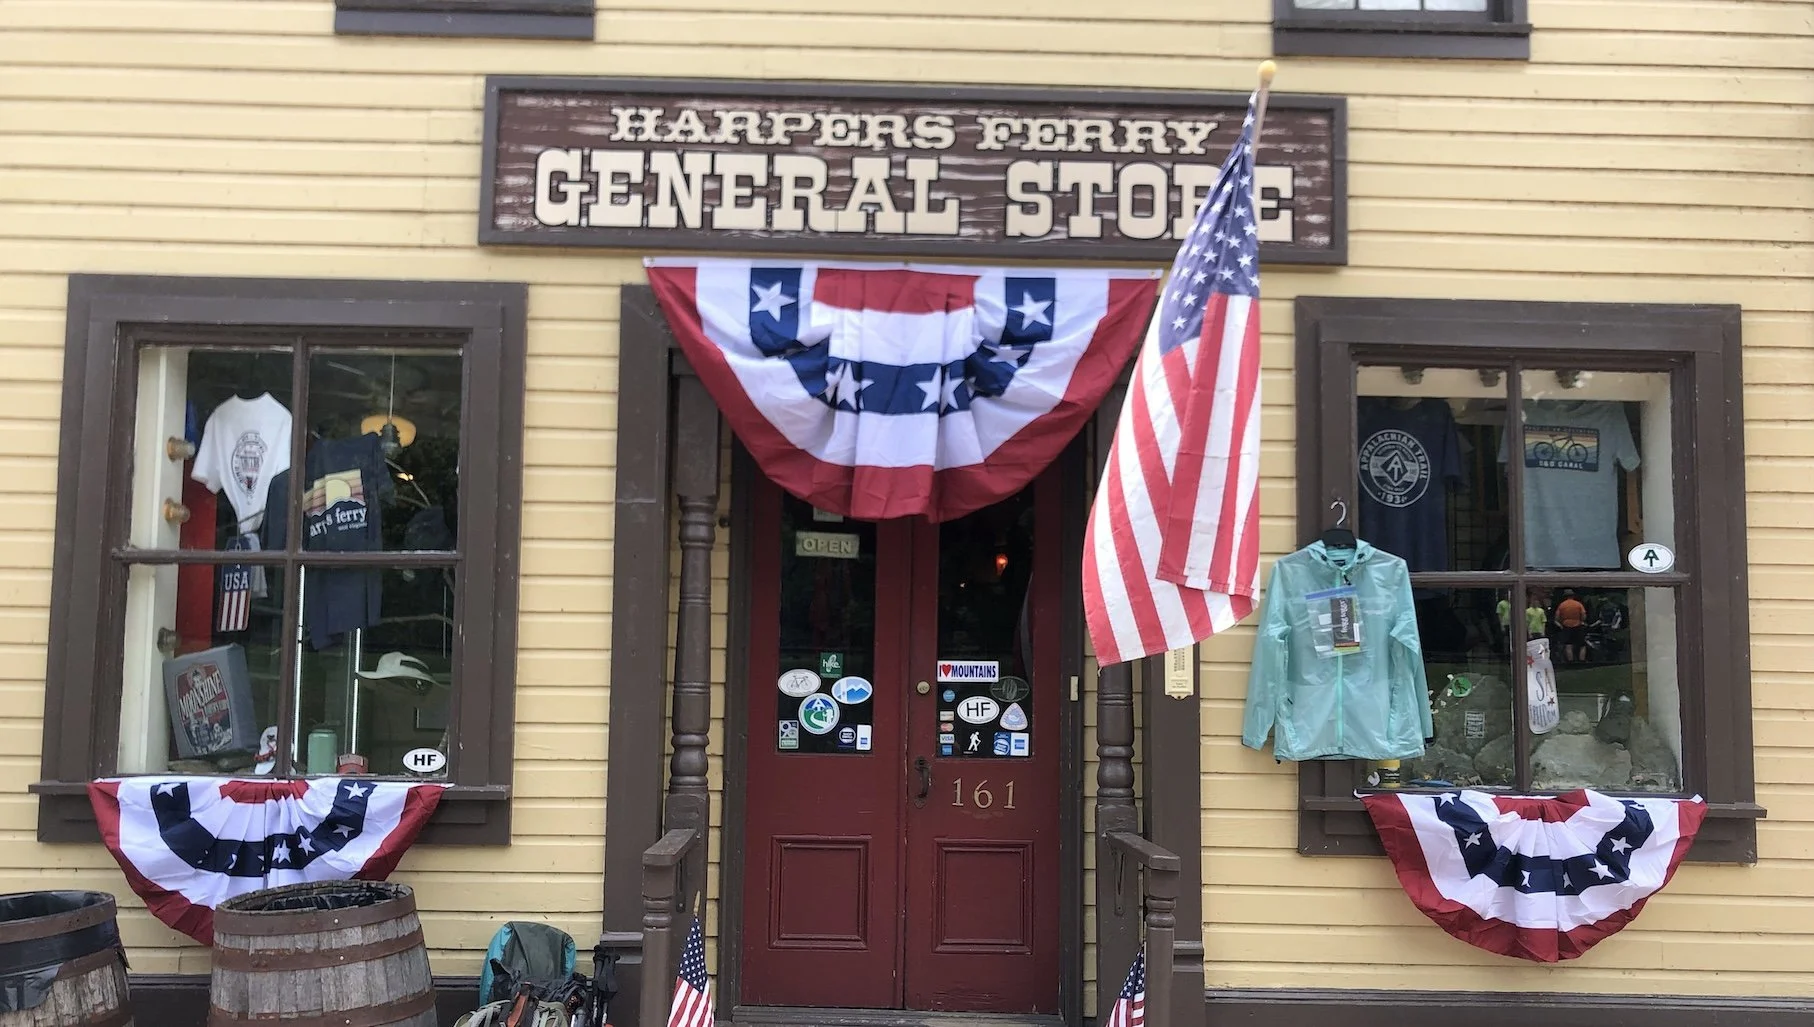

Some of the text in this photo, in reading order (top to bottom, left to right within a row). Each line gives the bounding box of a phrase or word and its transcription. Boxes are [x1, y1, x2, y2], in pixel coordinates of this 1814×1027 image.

[609, 106, 1219, 155] HARPERS FERRY
[533, 149, 960, 234] GENERAL
[1361, 433, 1416, 471] APPALACHIAN
[1414, 449, 1429, 479] TRAIL
[335, 507, 367, 524] ferry
[802, 538, 853, 555] OPEN
[224, 570, 249, 591] USA
[951, 665, 996, 678] MOUNTAINS
[180, 668, 224, 721] MOONSHINE
[966, 702, 991, 717] HF
[413, 754, 437, 767] HF
[952, 777, 1016, 810] 161
